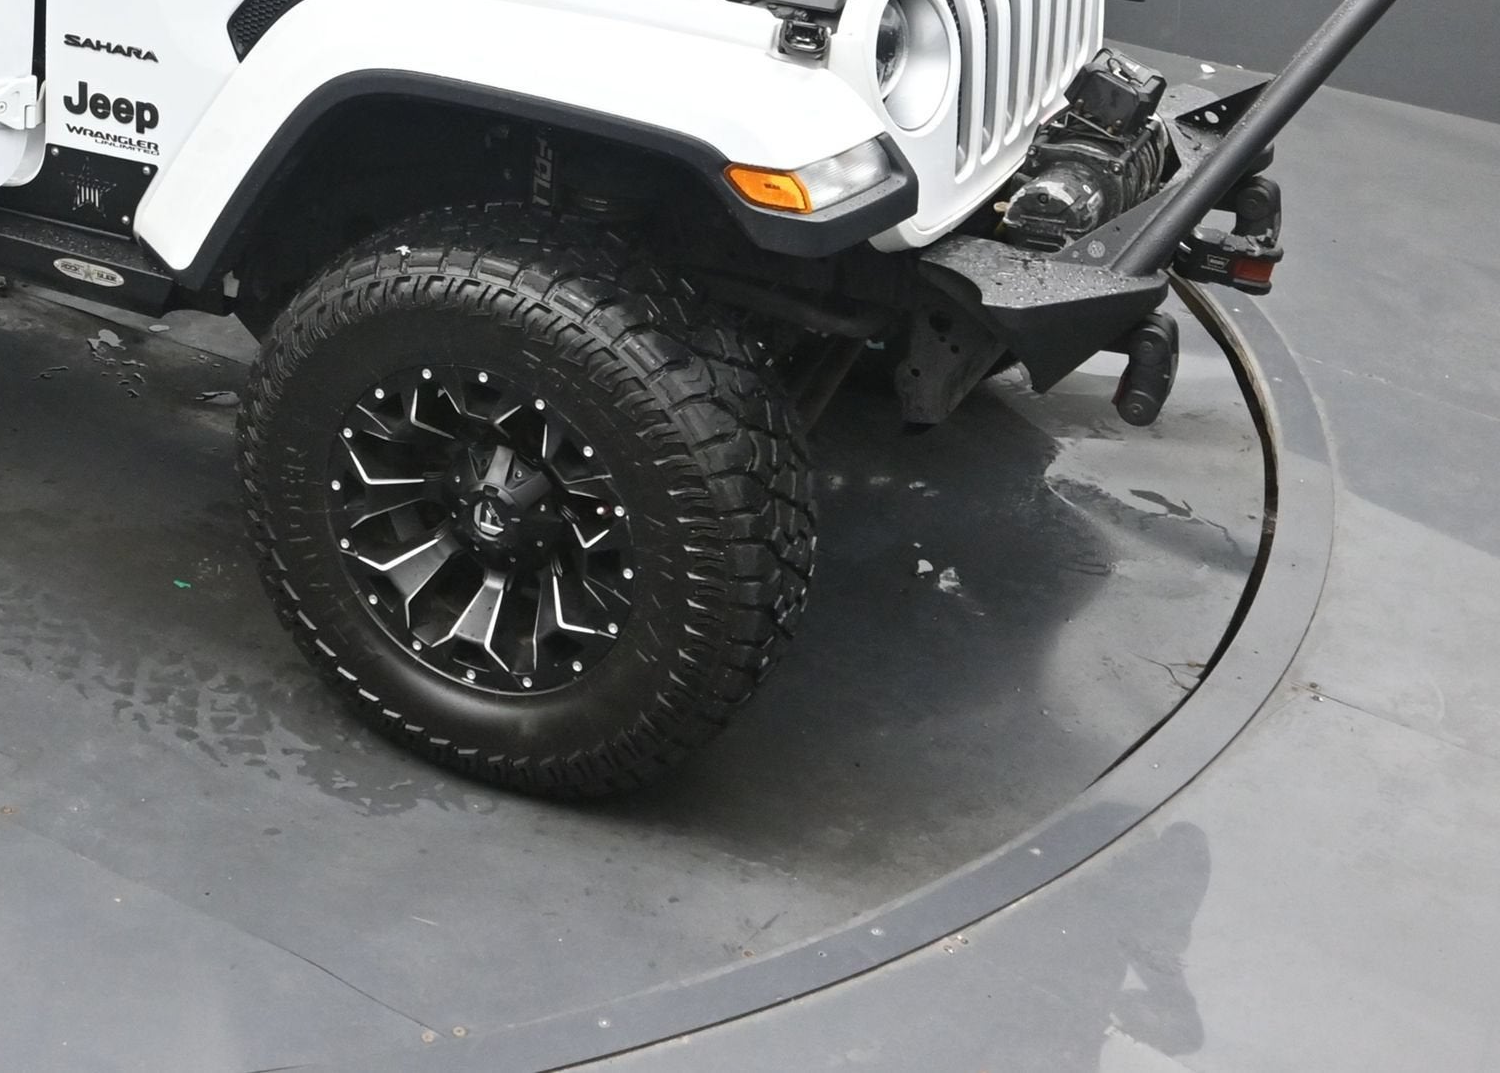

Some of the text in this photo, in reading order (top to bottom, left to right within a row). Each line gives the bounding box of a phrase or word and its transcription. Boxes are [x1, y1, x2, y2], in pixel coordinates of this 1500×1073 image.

[63, 33, 159, 63] SAHARA
[63, 80, 160, 134] Jeep
[65, 123, 160, 151] WRANGLER
[95, 139, 160, 156] UNLIMITED
